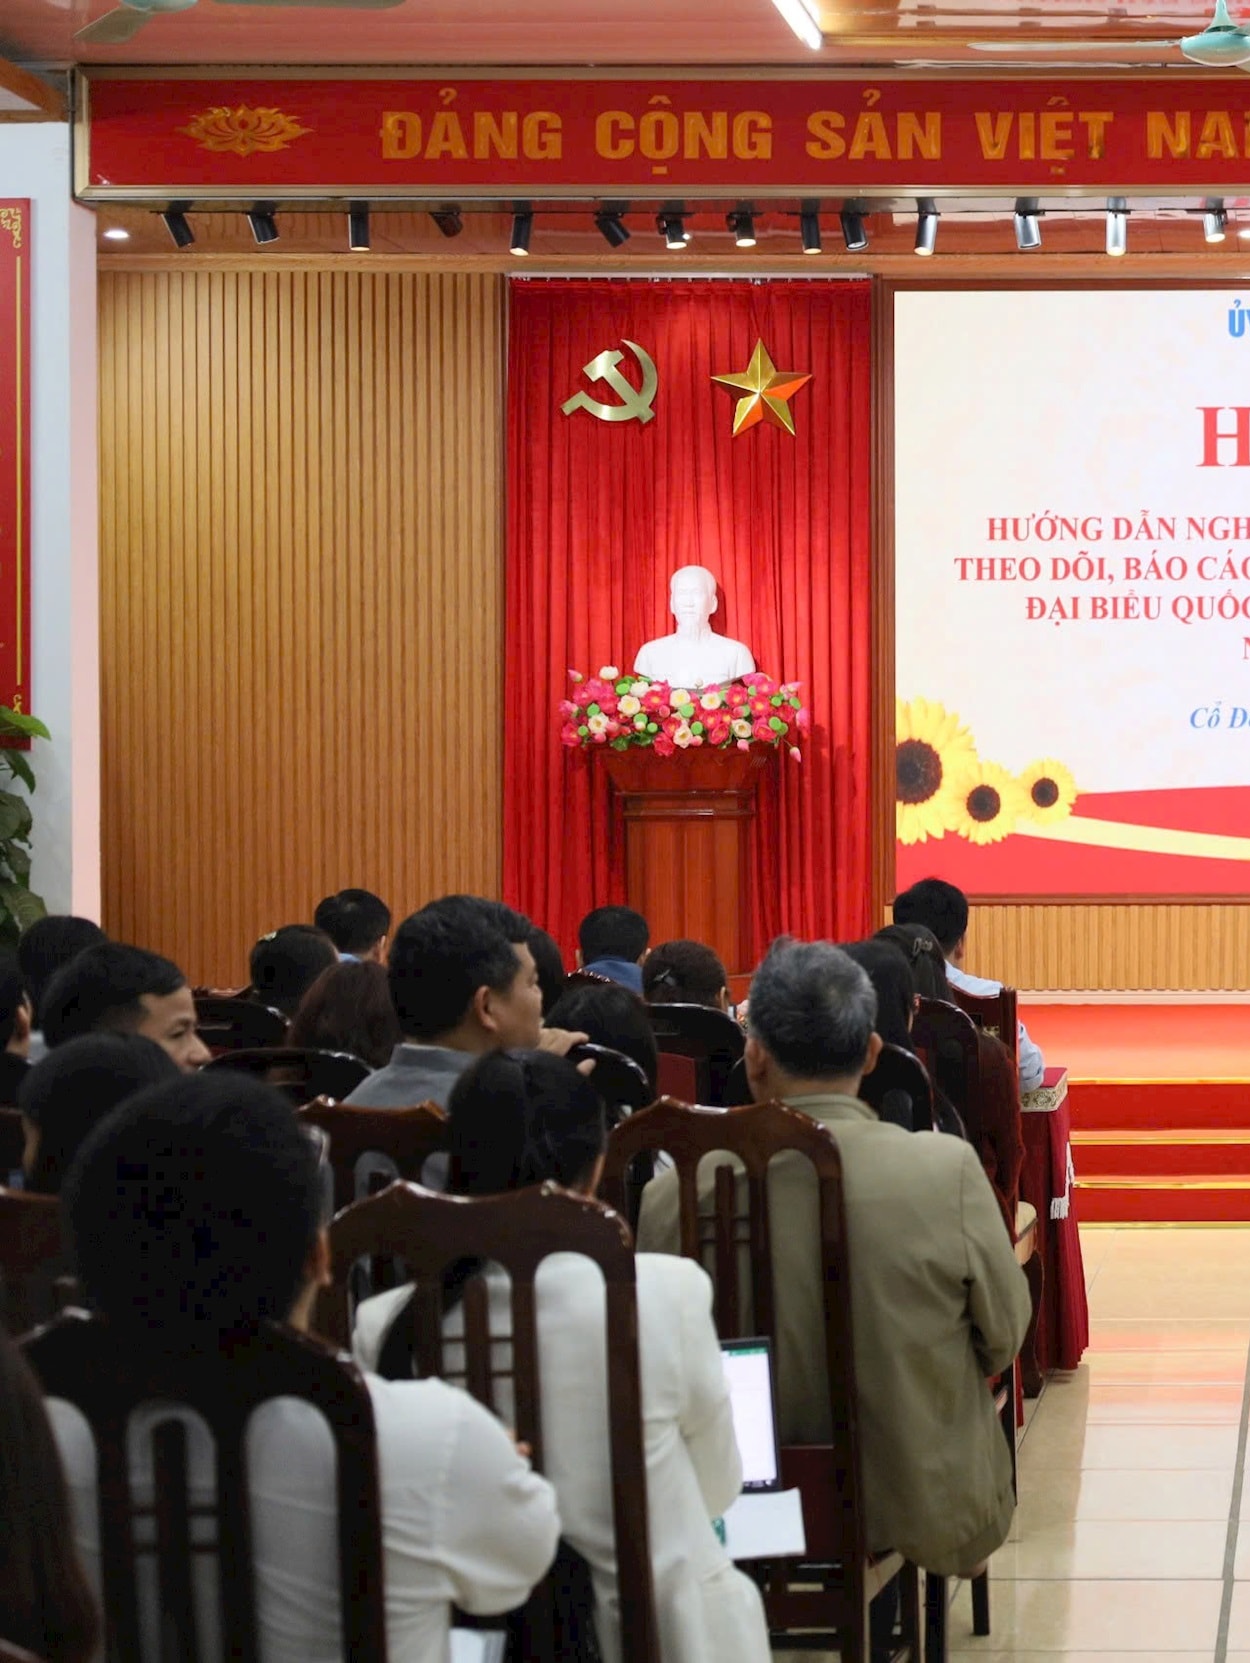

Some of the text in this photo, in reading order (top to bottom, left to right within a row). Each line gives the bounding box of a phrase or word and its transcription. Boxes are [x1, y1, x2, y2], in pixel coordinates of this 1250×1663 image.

[380, 88, 563, 161] ĐẢNG
[594, 95, 773, 176] CỘNG
[805, 89, 942, 160] SẢN
[974, 96, 1114, 176] VIỆT
[986, 511, 1103, 542] HƯỚNG
[1112, 508, 1177, 542] DẪN
[953, 556, 1042, 582] THEO
[1050, 550, 1115, 584] DÕI,
[1123, 550, 1189, 582] BÁO
[1025, 595, 1081, 627] ĐẠI
[1090, 588, 1163, 621] BIỂU
[1189, 700, 1221, 730] Cổ
